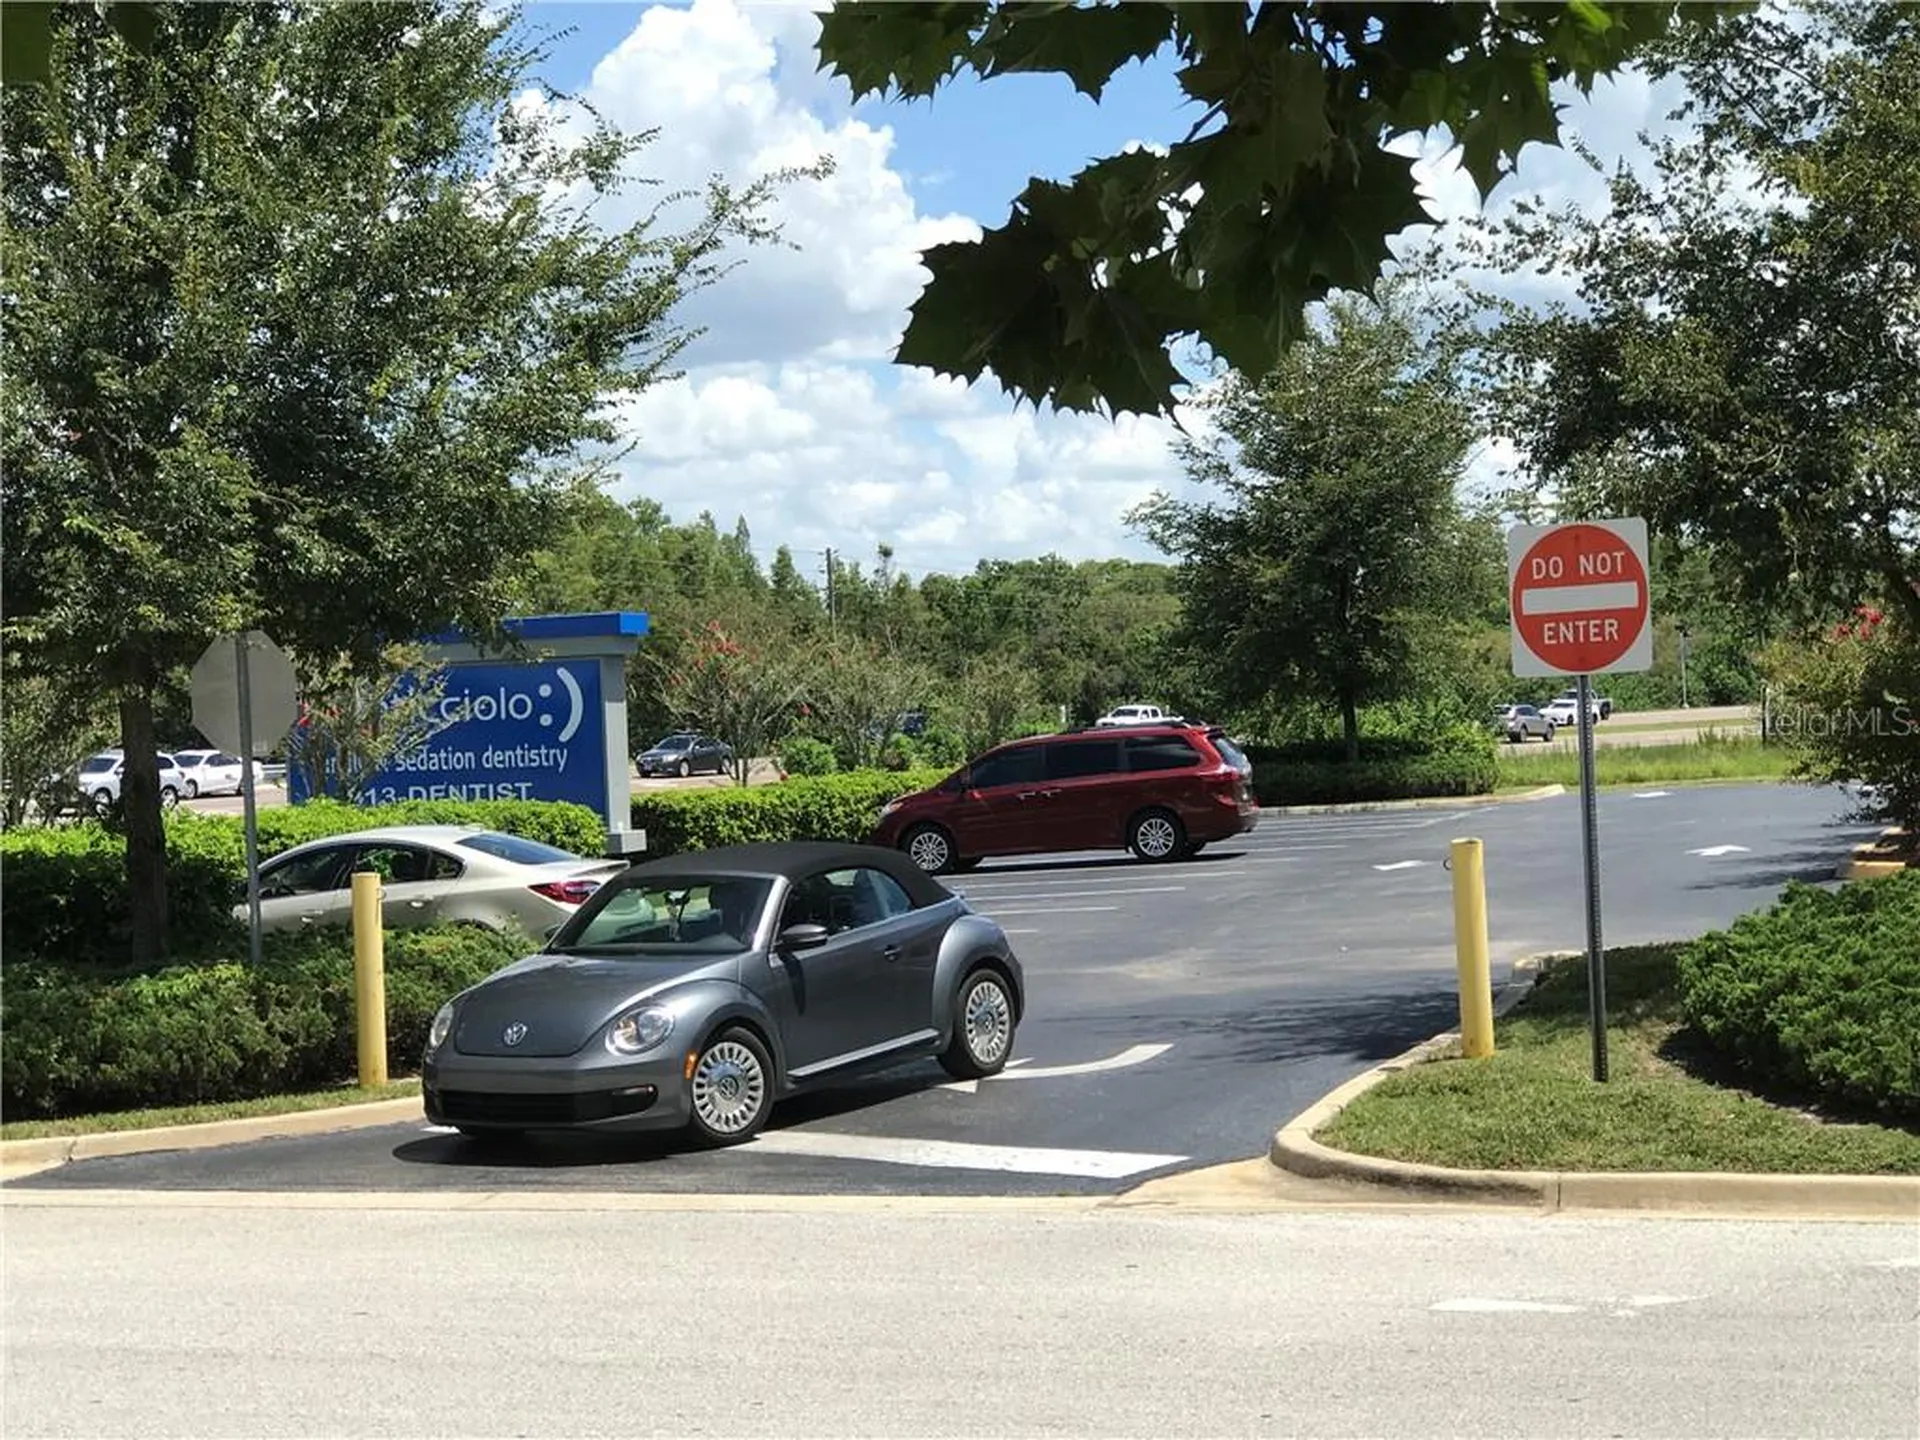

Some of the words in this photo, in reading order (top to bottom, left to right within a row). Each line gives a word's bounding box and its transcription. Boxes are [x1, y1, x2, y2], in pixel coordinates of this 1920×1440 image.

[1532, 556, 1563, 579] DO
[1579, 552, 1625, 576] NOT
[1544, 619, 1619, 645] ENTER
[395, 745, 476, 772] sedation
[482, 743, 568, 774] dentistry
